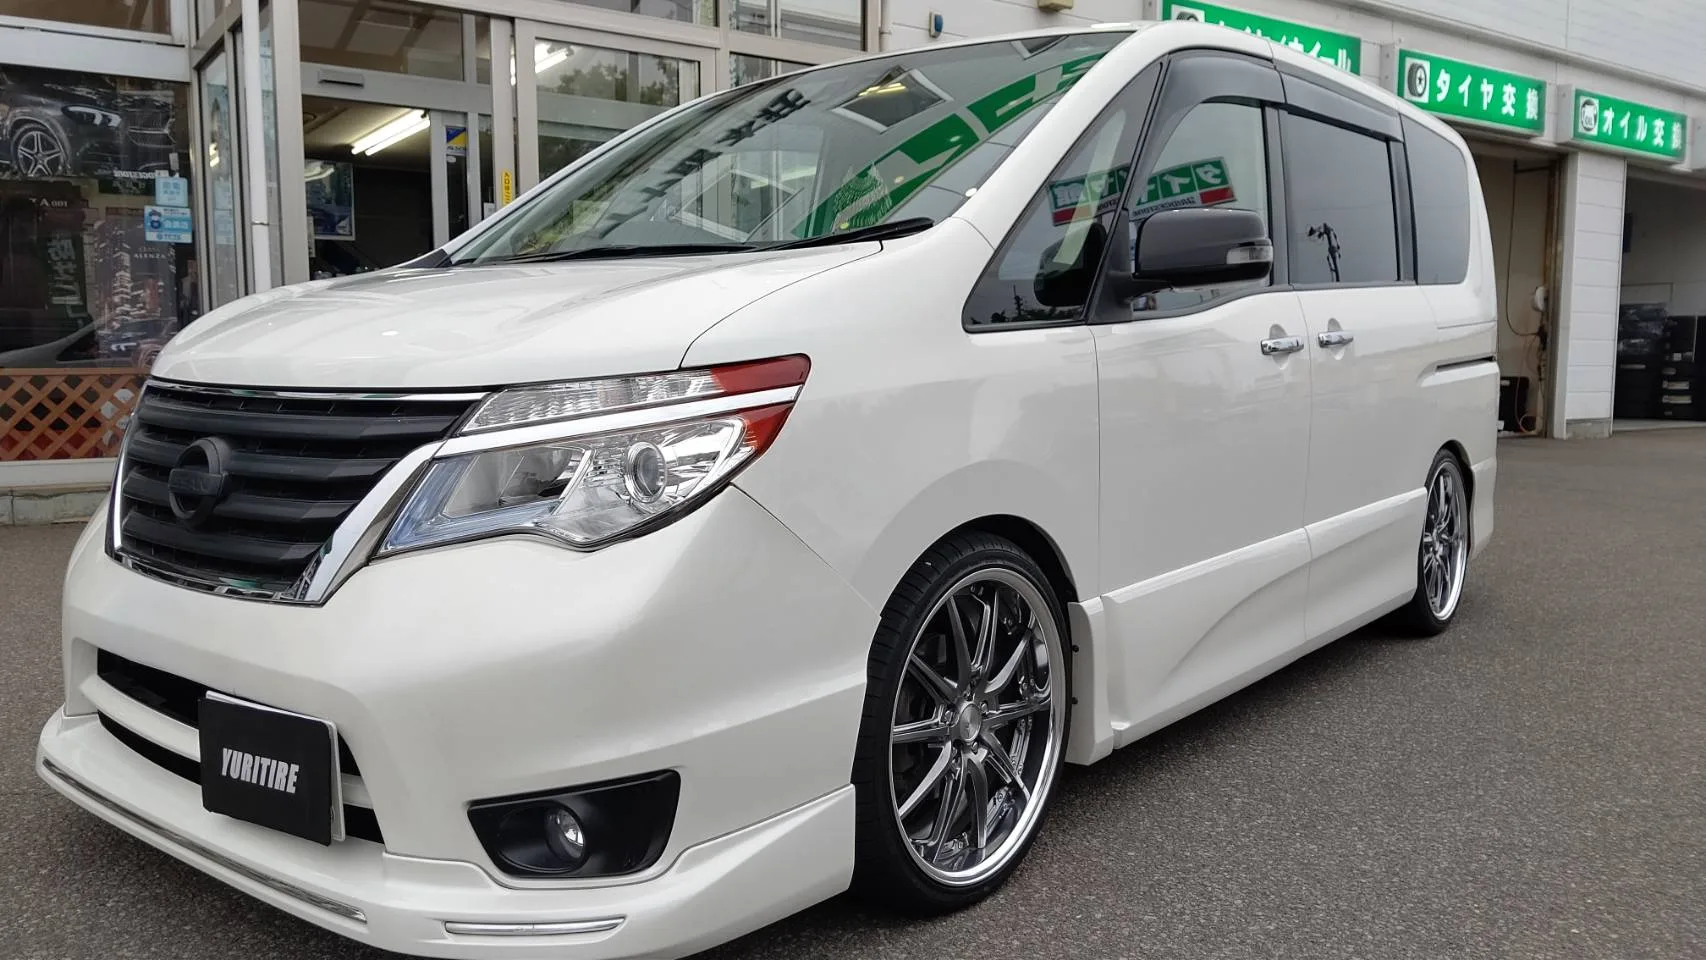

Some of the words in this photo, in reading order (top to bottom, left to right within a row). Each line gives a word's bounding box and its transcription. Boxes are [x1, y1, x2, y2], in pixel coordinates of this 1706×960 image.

[1436, 68, 1539, 120] タイヤ交換
[221, 747, 300, 794] YURITIRE
